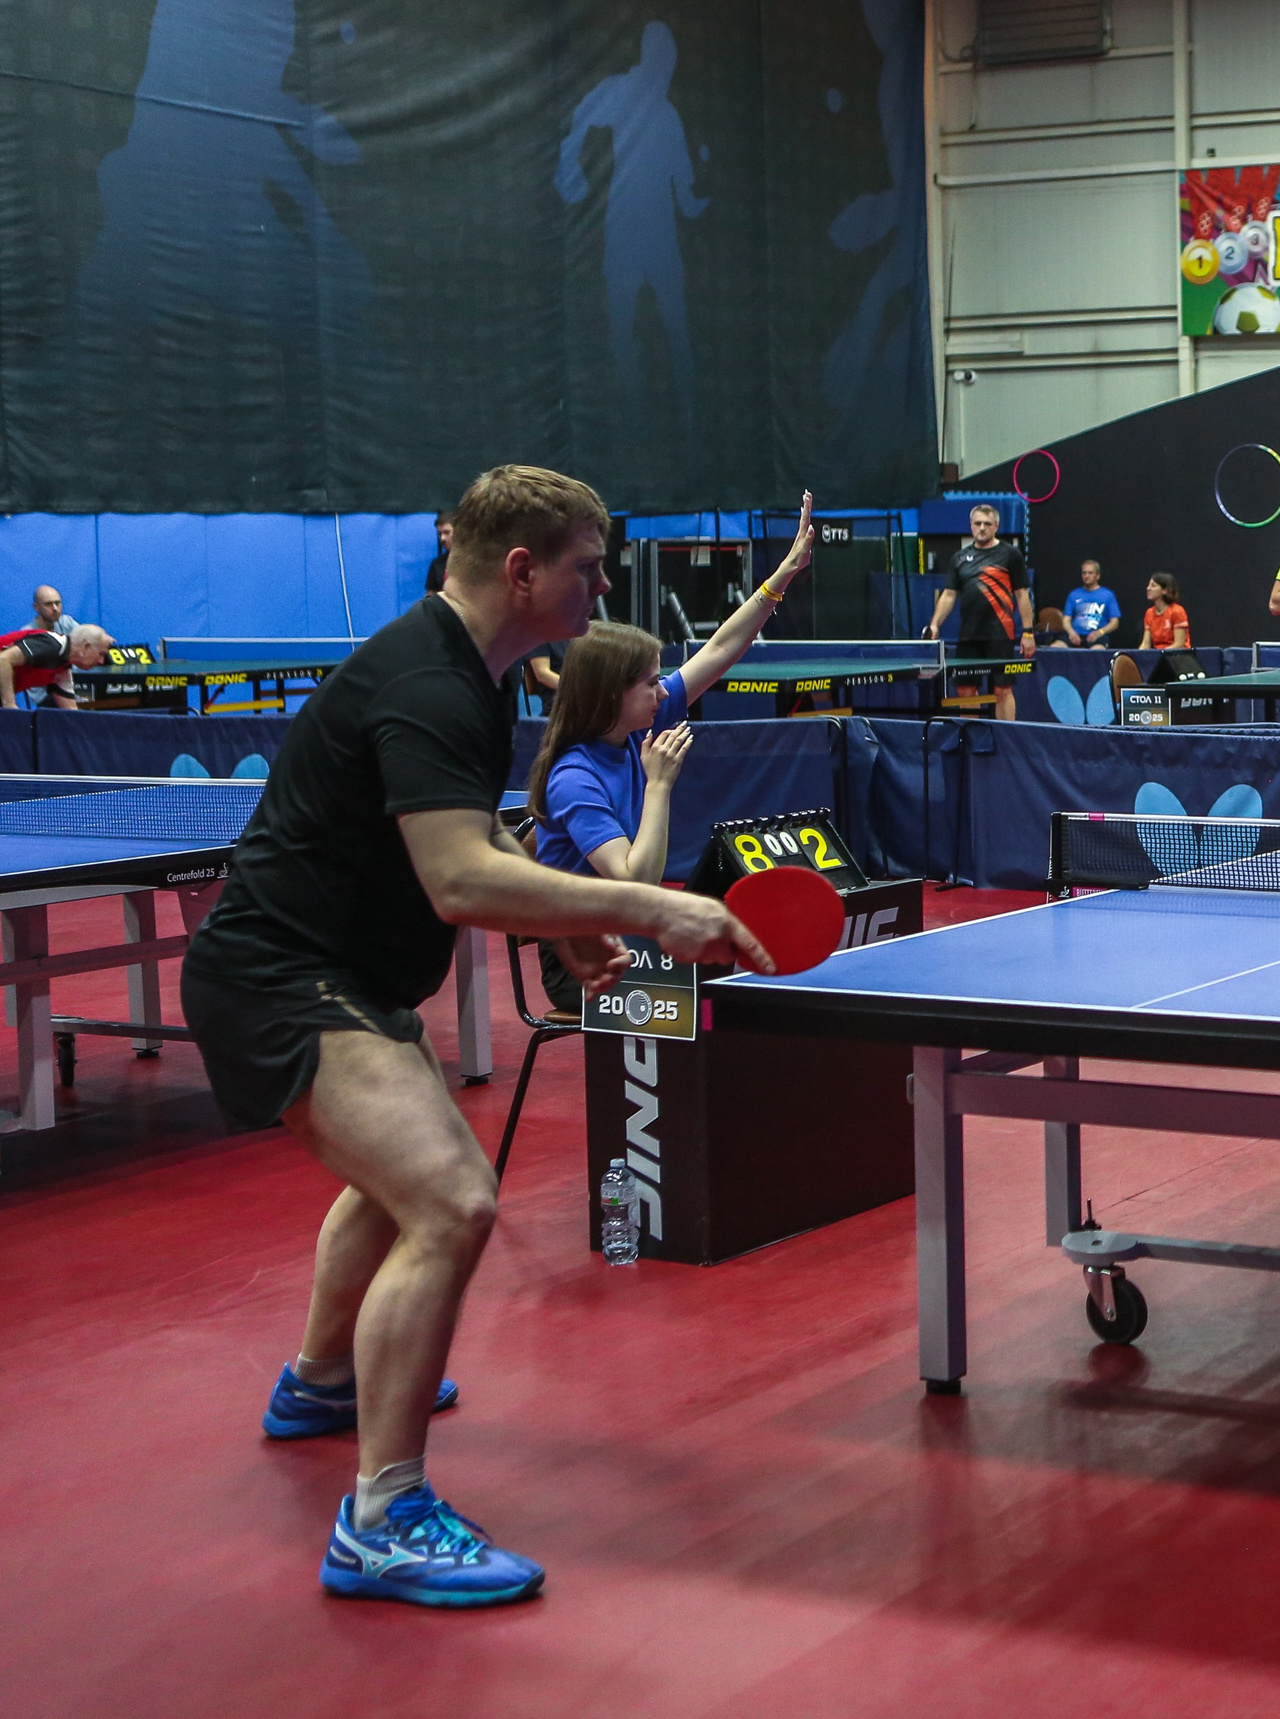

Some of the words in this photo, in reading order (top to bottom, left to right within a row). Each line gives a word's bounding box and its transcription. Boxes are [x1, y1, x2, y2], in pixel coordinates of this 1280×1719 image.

[1224, 245, 1236, 260] 2
[1197, 255, 1204, 269] 1
[135, 648, 152, 664] 2
[1004, 663, 1032, 674] DONIC
[205, 673, 247, 686] DONIC
[795, 679, 831, 692] DONIC
[727, 682, 778, 693] DONIC
[1129, 695, 1152, 704] СТОЛ
[1154, 695, 1162, 704] 11
[734, 834, 775, 873] 8
[799, 828, 842, 869] 2
[167, 868, 205, 882] Centrefold
[206, 868, 215, 877] 25
[627, 949, 654, 969] ОЛ
[660, 953, 674, 971] 8
[599, 995, 624, 1015] 20
[653, 1000, 678, 1020] 25
[624, 1036, 663, 1241] ONIC
